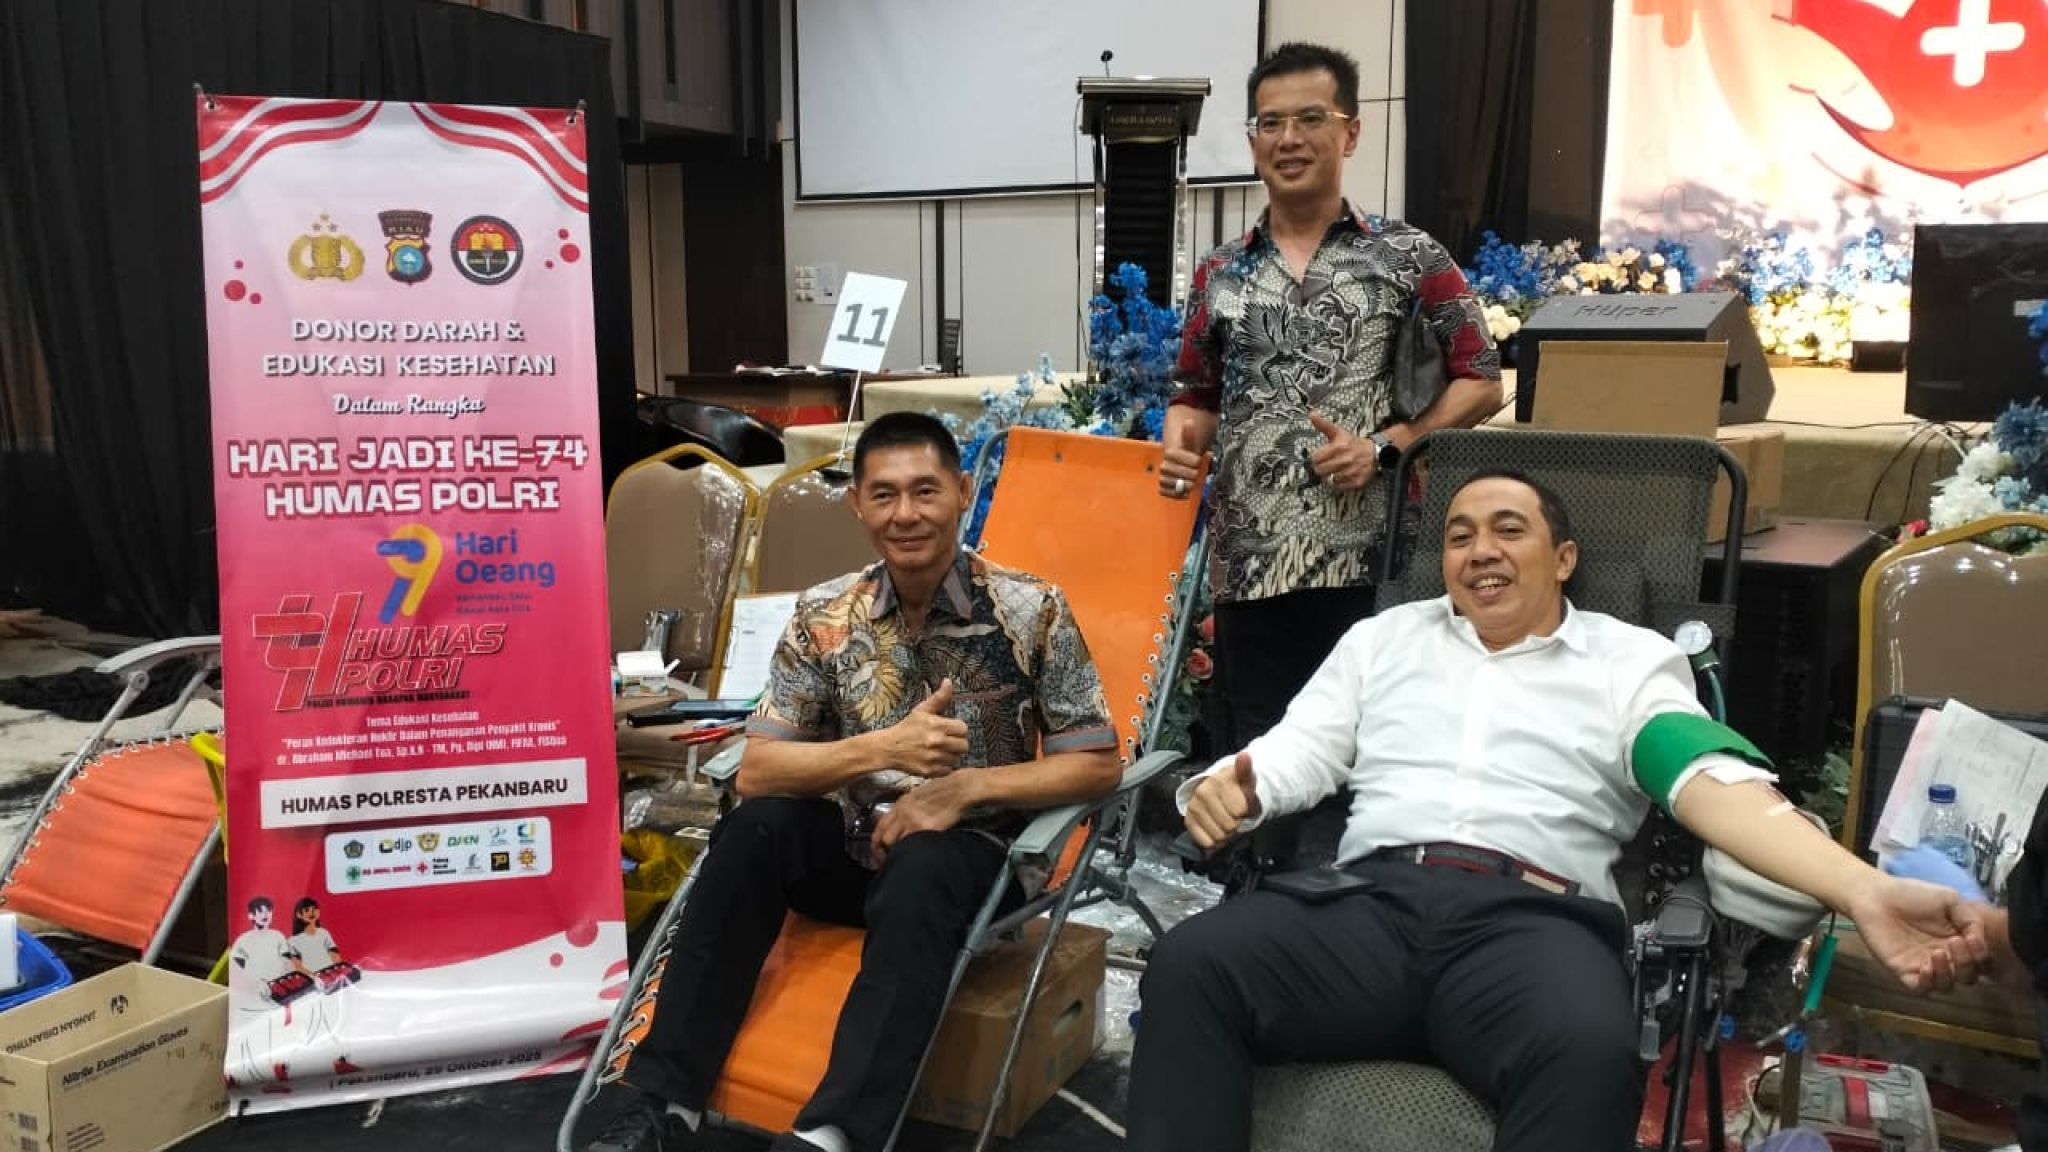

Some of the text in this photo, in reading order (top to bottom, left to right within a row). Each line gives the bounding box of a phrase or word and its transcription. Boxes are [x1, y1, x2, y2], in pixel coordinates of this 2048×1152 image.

[293, 319, 525, 341] DONOR DARAH &
[837, 303, 888, 347] 11
[263, 354, 555, 376] EDUKASI KESEHATAN
[333, 393, 486, 418] Dalam Rangka
[229, 436, 589, 475] HARI JADI KE-74
[265, 479, 560, 517] HUMAS POLRI
[455, 529, 518, 555] Hari
[455, 560, 555, 586] Oeang
[348, 624, 506, 660] HUMAS
[340, 658, 462, 693] POLRI
[393, 713, 429, 725] Edukasi
[281, 778, 568, 814] HUMAS POLRESTA PEKANBARU
[63, 1065, 94, 1085] Nitrile
[96, 1041, 156, 1071] Examination
[157, 1025, 188, 1046] Gloves
